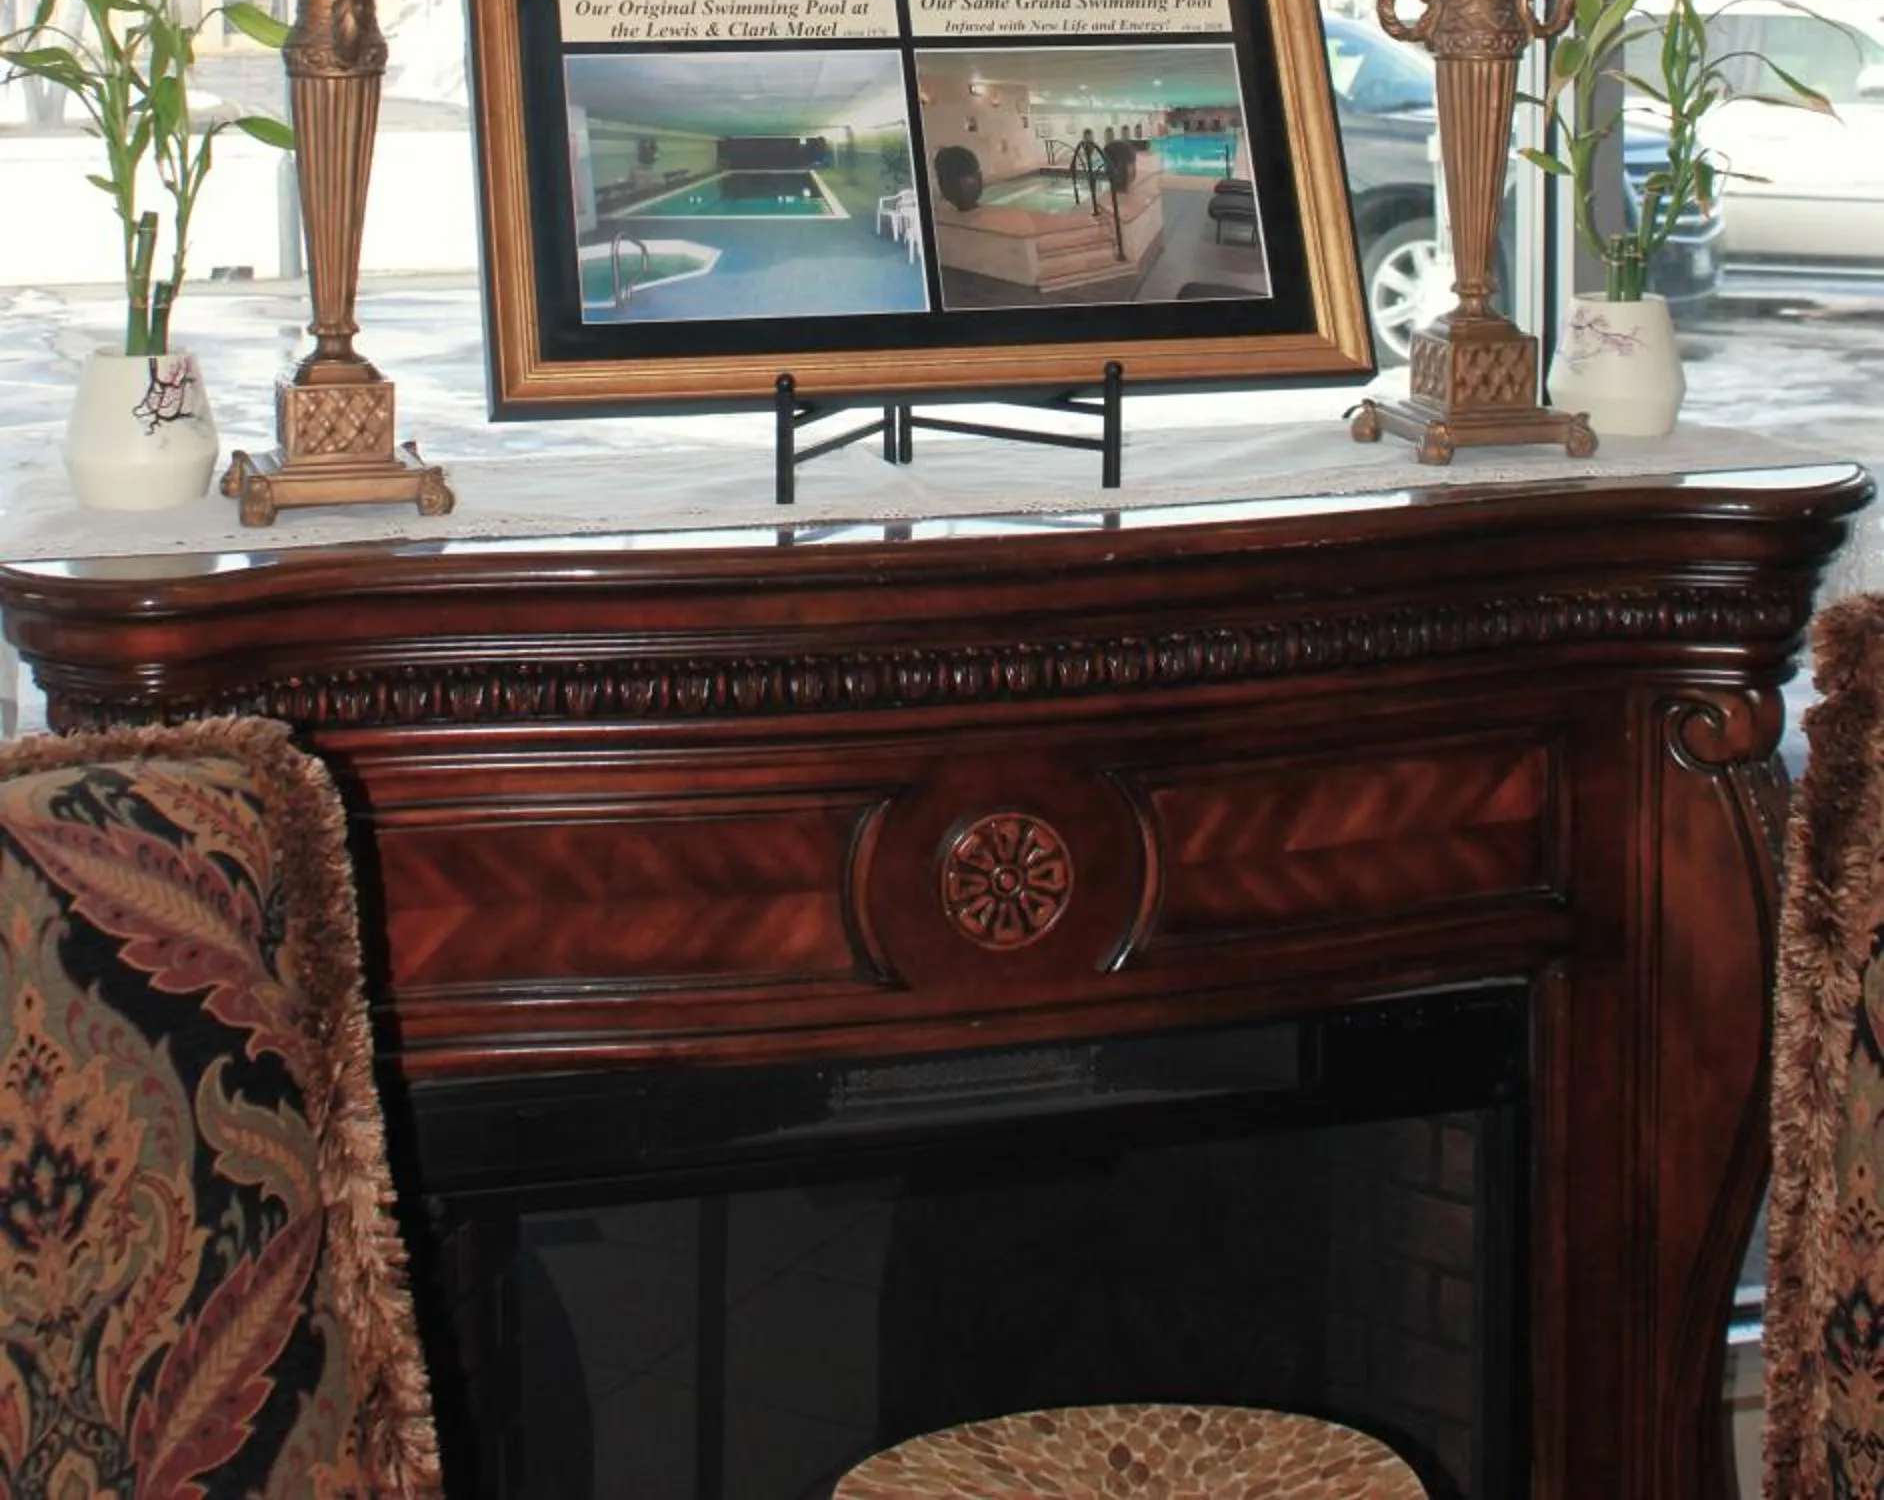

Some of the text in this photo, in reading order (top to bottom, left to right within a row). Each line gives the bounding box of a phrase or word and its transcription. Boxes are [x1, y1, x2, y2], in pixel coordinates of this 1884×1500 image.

[575, 0, 870, 19] Our Original Swimming Pool at
[610, 22, 640, 37] the
[646, 22, 699, 37] Lewis
[705, 22, 720, 37] &
[727, 21, 778, 37] Clark
[785, 21, 838, 37] Motel
[944, 20, 995, 34] Infused
[999, 19, 1026, 32] with
[1028, 19, 1059, 32] New
[1062, 19, 1089, 33] Life
[1091, 19, 1117, 31] and
